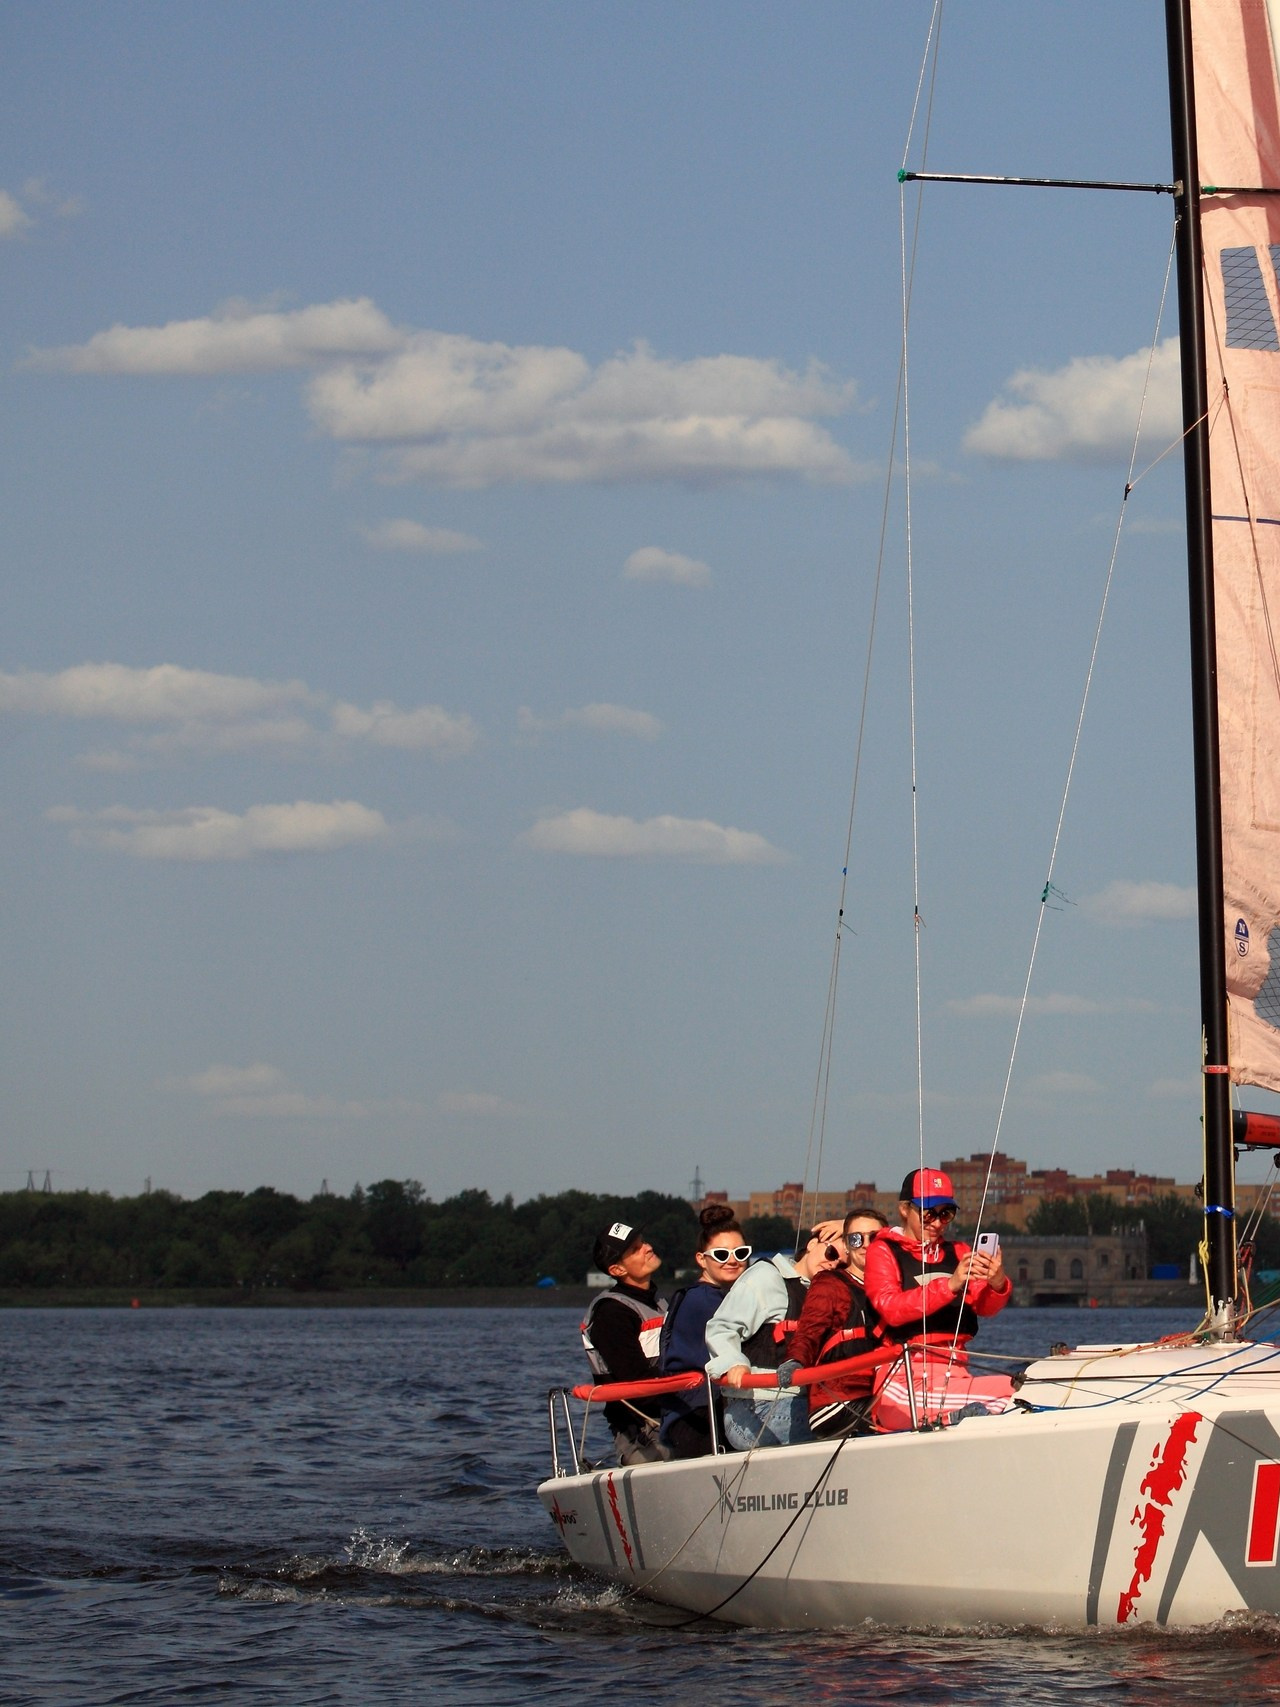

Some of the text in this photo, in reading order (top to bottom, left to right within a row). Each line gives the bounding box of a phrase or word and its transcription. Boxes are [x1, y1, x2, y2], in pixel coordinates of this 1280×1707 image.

[1238, 922, 1246, 934] N
[1239, 941, 1246, 953] S
[737, 1492, 799, 1513] SAILING
[804, 1488, 849, 1509] CLUB
